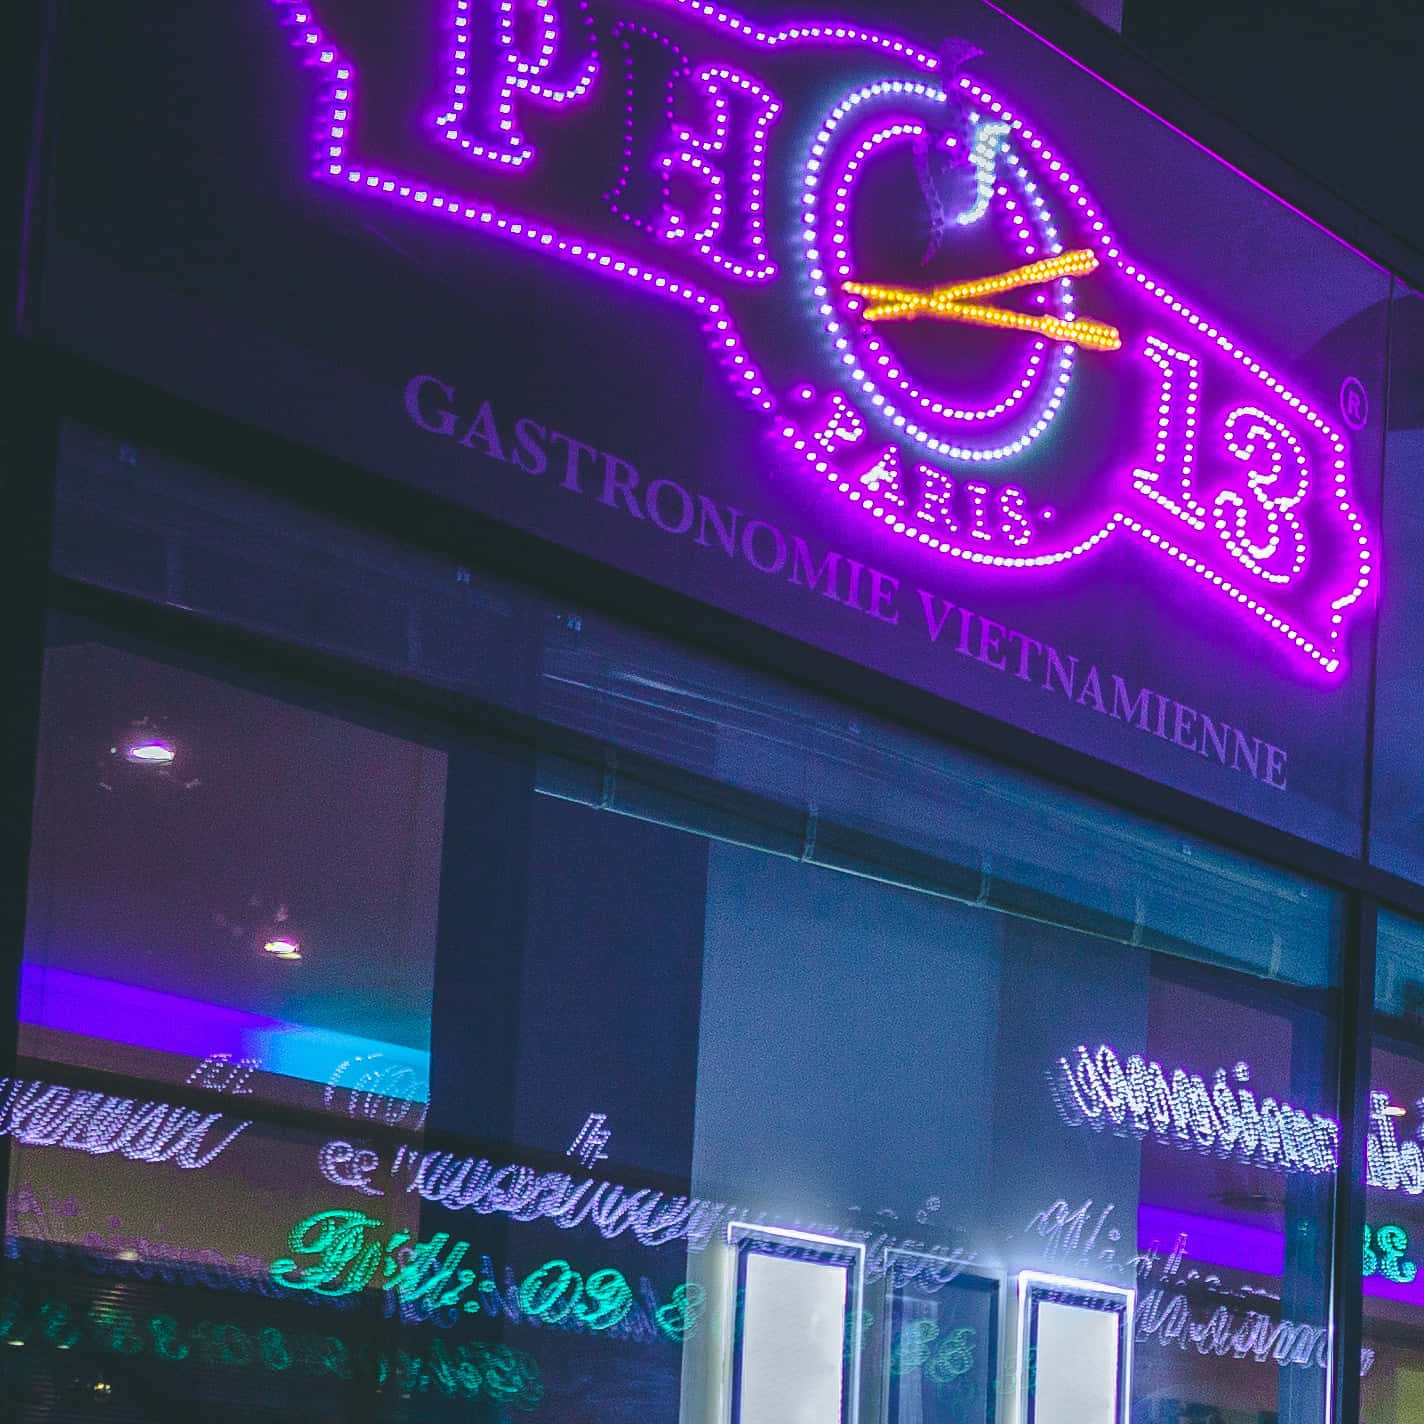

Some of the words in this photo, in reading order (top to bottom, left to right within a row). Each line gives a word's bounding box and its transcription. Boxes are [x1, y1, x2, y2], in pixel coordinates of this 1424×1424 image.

[403, 374, 900, 626] GASTRONOMIE
[916, 588, 1289, 790] VIETNAMIENNE
[811, 395, 1032, 546] PARIS
[1131, 335, 1309, 583] 13
